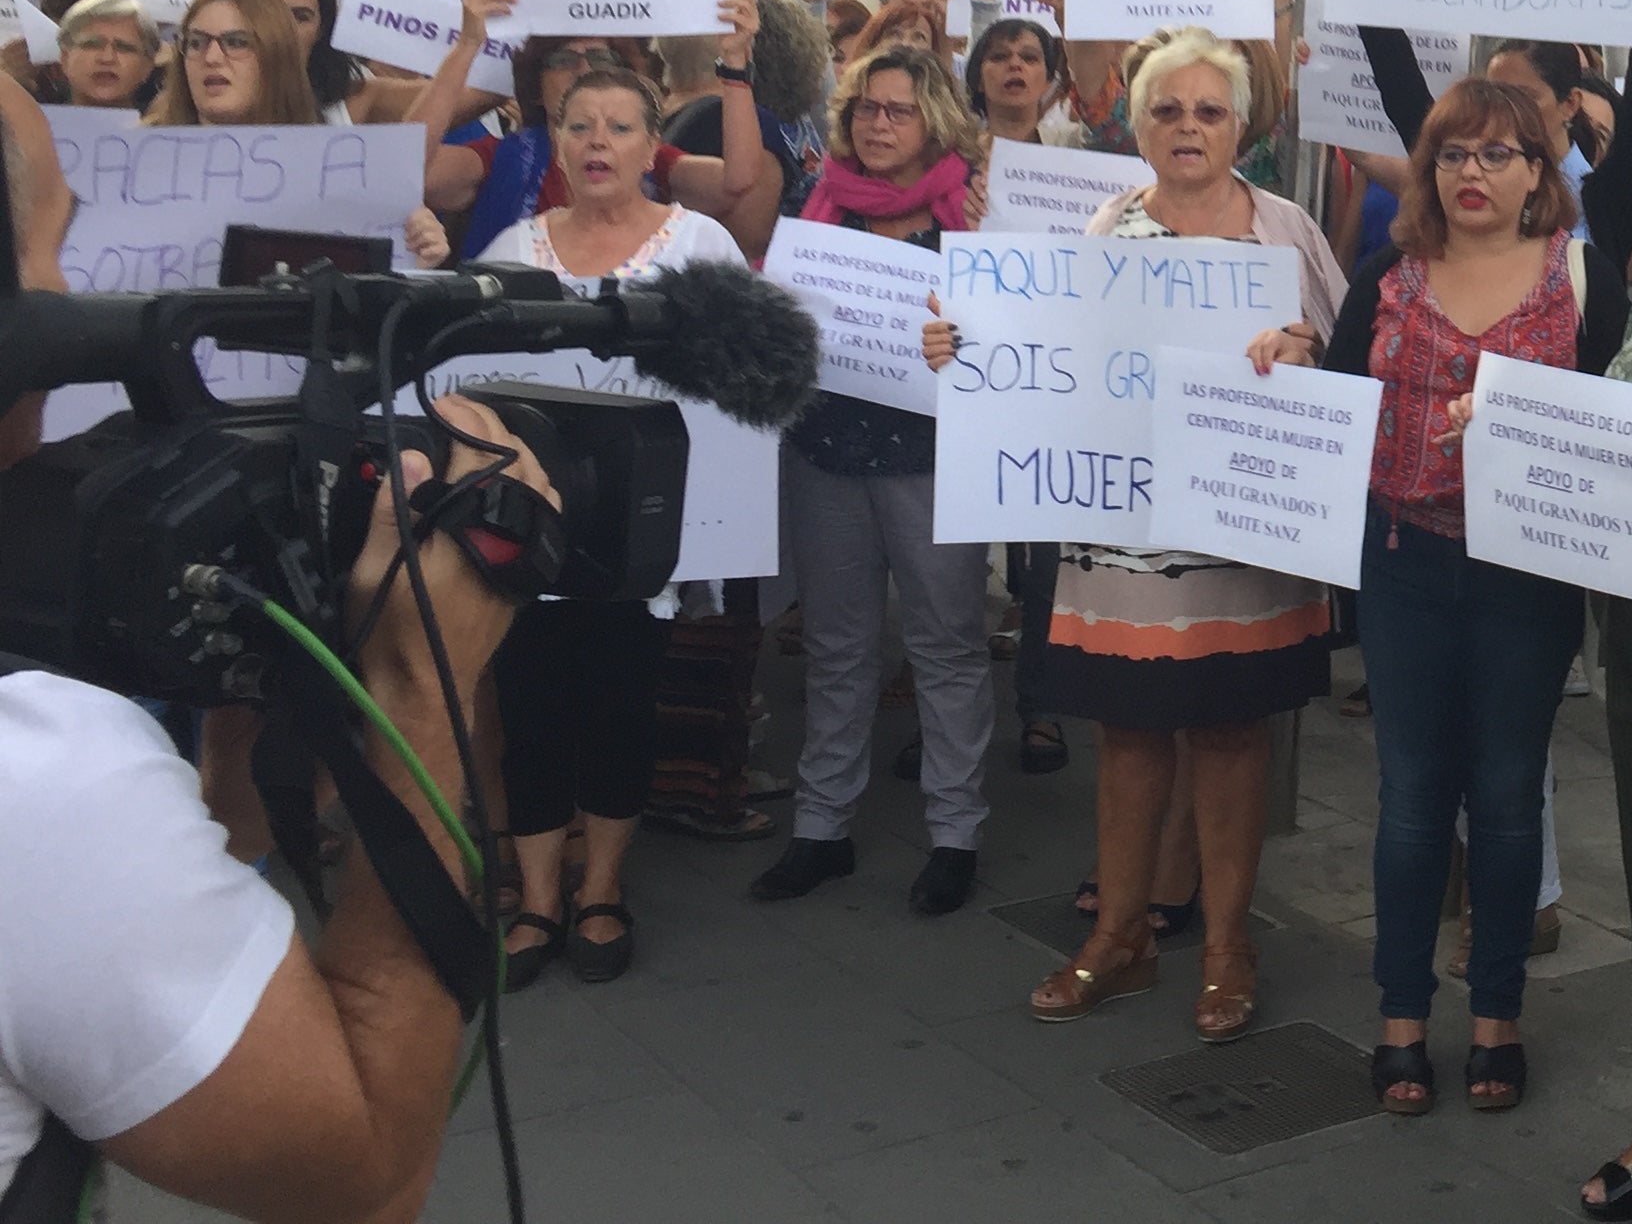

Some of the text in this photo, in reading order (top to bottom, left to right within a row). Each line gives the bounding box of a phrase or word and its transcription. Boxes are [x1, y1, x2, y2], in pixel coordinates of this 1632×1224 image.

[358, 2, 440, 41] PINOS
[568, 2, 652, 20] GUADIX
[1126, 4, 1215, 17] MAITE SANZ
[1416, 36, 1458, 51] DE LOS
[1435, 61, 1453, 73] EN
[1322, 90, 1361, 108] PAQUI
[55, 133, 367, 205] RACIAS A
[1004, 167, 1125, 194] LAS PROFESIONALES
[1008, 192, 1063, 212] CENTROS
[1066, 200, 1082, 214] DE
[793, 246, 926, 283] LAS PROFESIONALES
[949, 247, 1272, 310] PAQUI Y MAITE
[792, 271, 893, 302] CENTROS DE LA
[833, 305, 909, 332] APOYO DE
[867, 361, 909, 383] SANZ
[952, 341, 1077, 394] SOIS
[1183, 382, 1352, 426] LAS PROFESIONALES DE LOS
[1486, 389, 1504, 406] LAS
[1507, 394, 1595, 428] PROFESIONALES
[1598, 415, 1613, 431] DE
[1187, 413, 1343, 455] CENTROS DE LA MUJER EN
[1489, 422, 1539, 447] CENTROS
[1541, 434, 1555, 452] DE
[1558, 438, 1572, 455] LA
[1575, 443, 1616, 465] MUJER
[998, 447, 1154, 512] MUJER
[1229, 451, 1297, 480] APOYO DE
[1527, 464, 1595, 494] APOYO DE
[1190, 475, 1331, 519] PAQUI GRANADOS Y
[1495, 489, 1536, 513] PAQUI
[1539, 500, 1621, 534] GRANADOS
[1215, 509, 1301, 544] MAITE SANZ
[1521, 525, 1610, 561] MAITE SANZ
